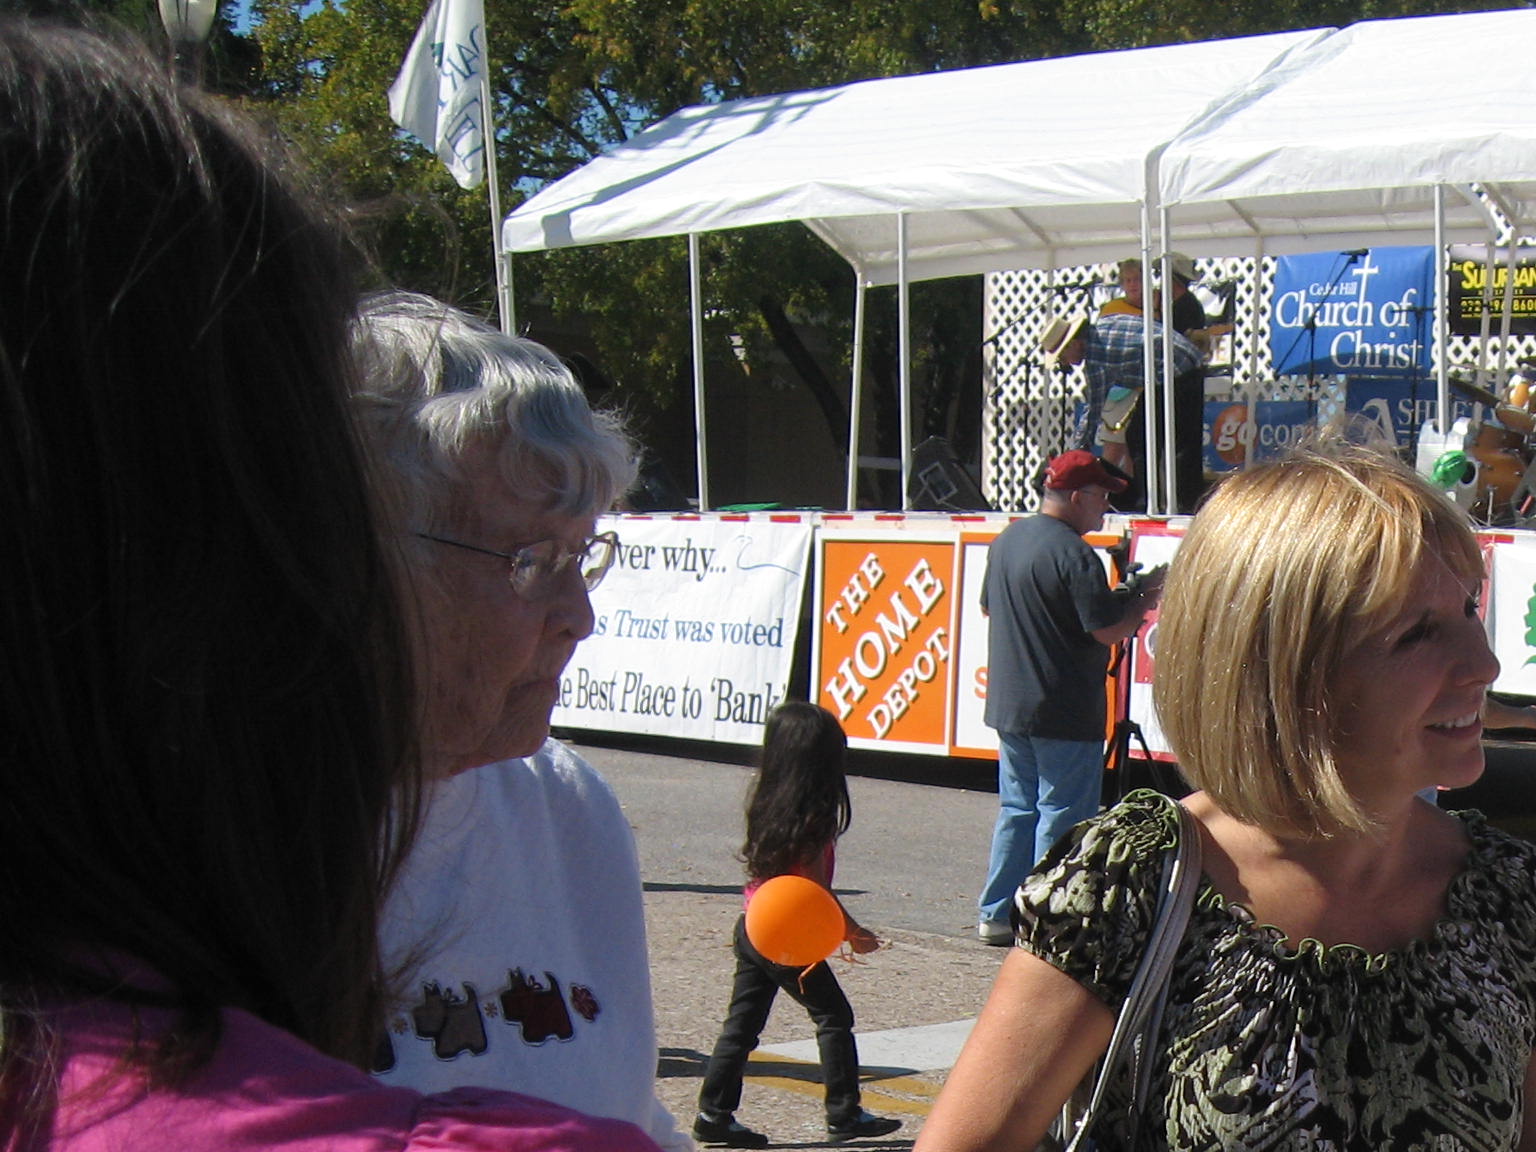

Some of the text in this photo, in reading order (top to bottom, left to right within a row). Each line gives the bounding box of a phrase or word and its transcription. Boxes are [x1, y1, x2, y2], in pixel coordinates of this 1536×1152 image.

[1275, 288, 1416, 327] Church of
[1339, 282, 1357, 295] Hill
[1330, 329, 1423, 369] Christ
[826, 552, 885, 633] THE
[614, 609, 669, 641] Trust
[674, 618, 715, 643] was
[721, 614, 784, 648] voted
[825, 558, 945, 721] HOME
[576, 667, 617, 712] Best
[620, 671, 676, 718] Place
[682, 674, 702, 720] to
[867, 627, 948, 740] DEPOT
